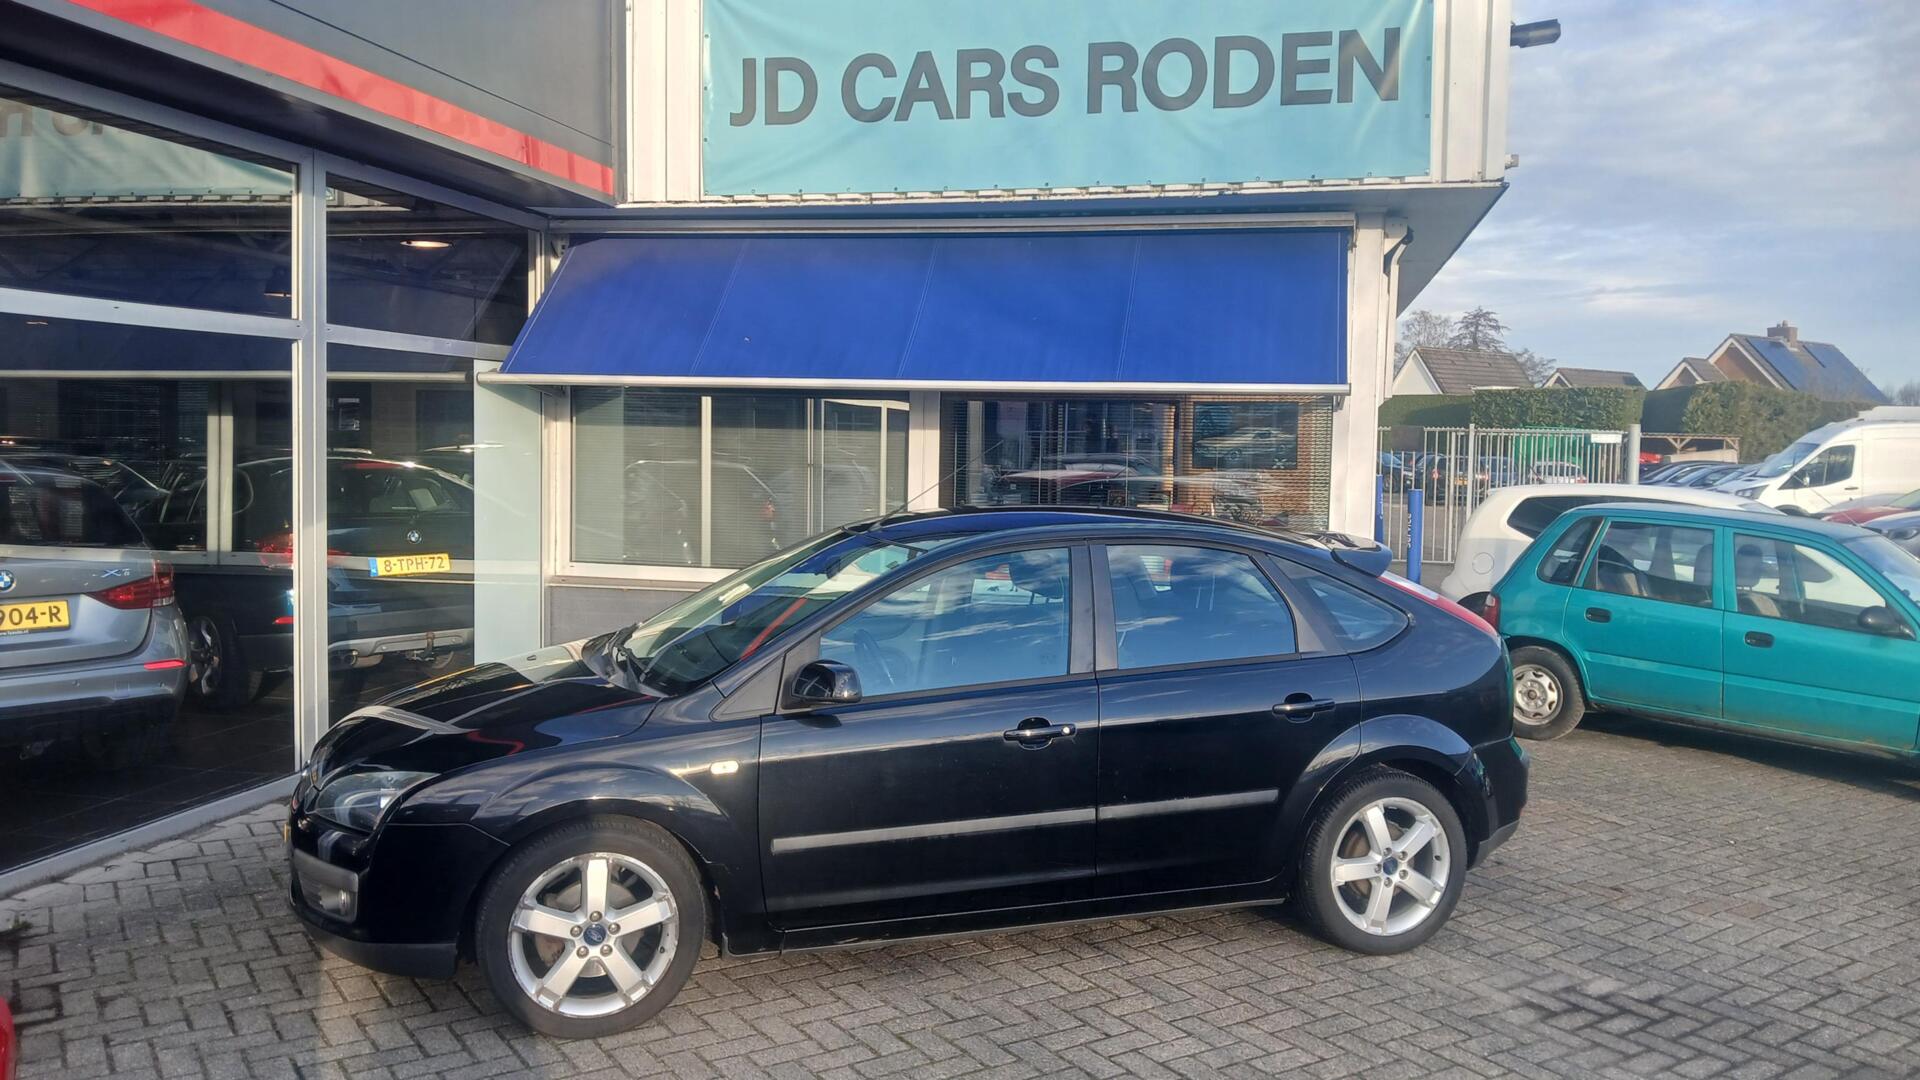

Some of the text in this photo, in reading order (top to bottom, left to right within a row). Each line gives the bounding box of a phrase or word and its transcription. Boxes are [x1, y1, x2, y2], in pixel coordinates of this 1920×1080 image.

[729, 27, 1401, 126] JD CARS RODEN
[383, 556, 445, 573] 8-TPH-72
